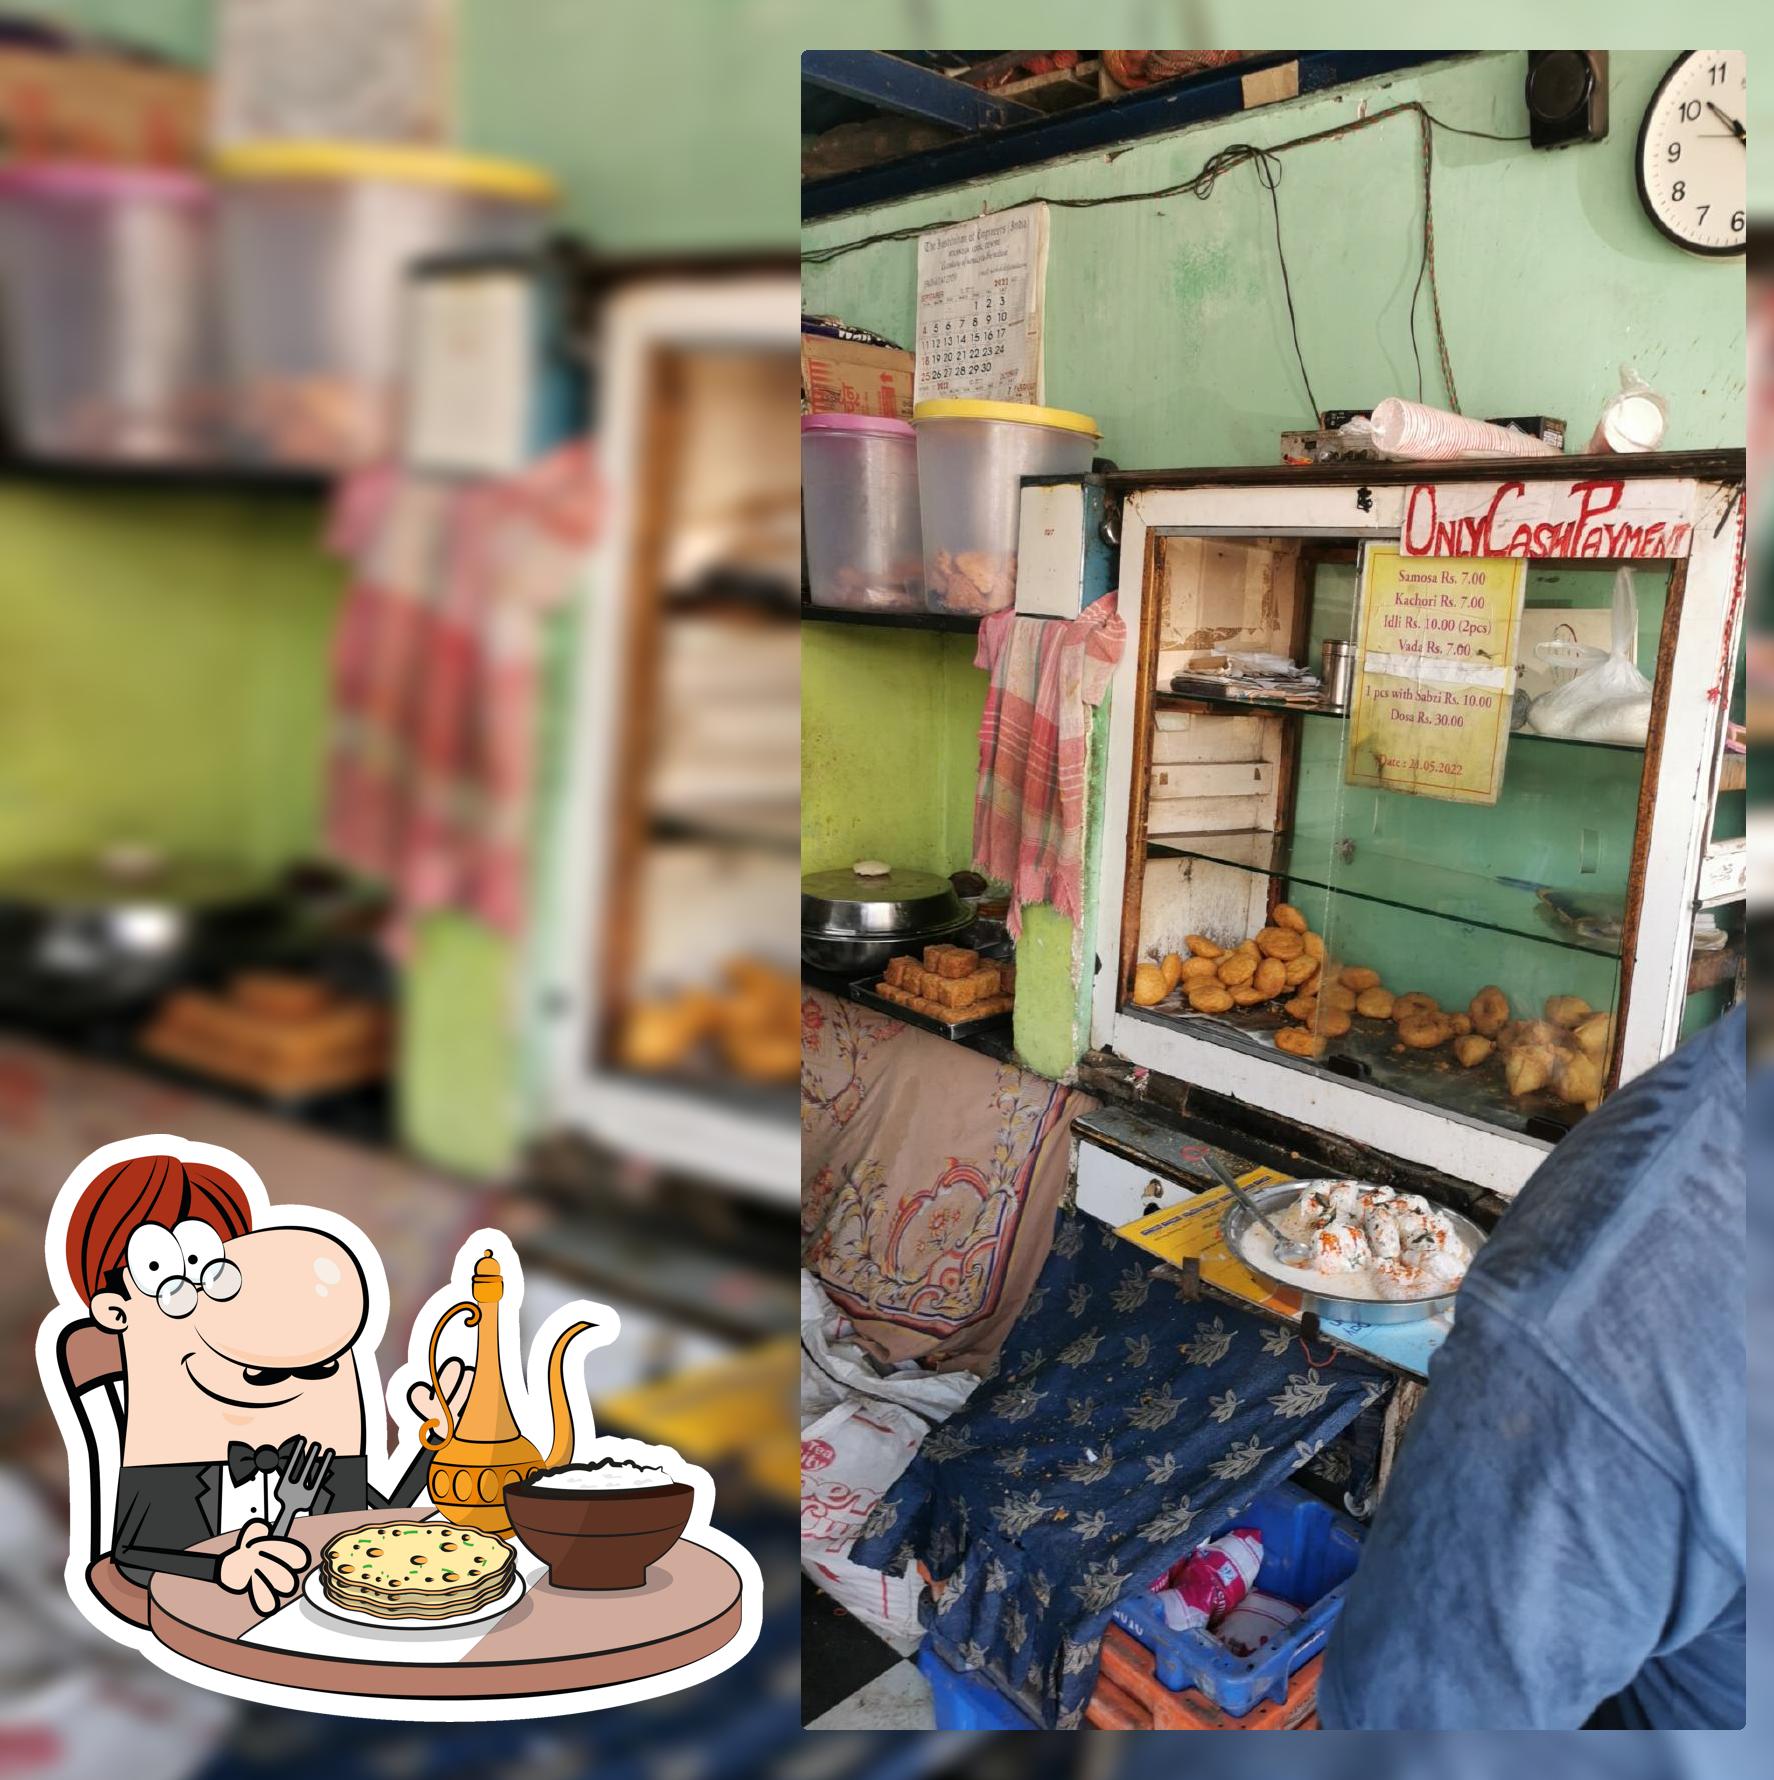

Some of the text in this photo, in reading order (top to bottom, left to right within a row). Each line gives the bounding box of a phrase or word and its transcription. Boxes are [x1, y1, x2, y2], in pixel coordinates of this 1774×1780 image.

[1708, 61, 1727, 86] 11
[1678, 100, 1702, 123] 10
[1667, 142, 1681, 163] 9
[1671, 180, 1686, 202] 8
[1696, 205, 1711, 226] 7
[1730, 211, 1745, 232] 6
[986, 299, 992, 308] 2
[1000, 296, 1005, 306] 3
[933, 323, 939, 333] 5
[945, 321, 951, 330] 6
[960, 320, 965, 328] 7
[972, 317, 978, 327] 8
[986, 315, 991, 324] 9
[997, 312, 1007, 322] 10
[922, 328, 1006, 350] 11 12 13 14 15 16 17
[922, 345, 1005, 366] 18 19 20 21 22 23 24
[921, 362, 992, 382] 25 26 27 28 29 30
[1398, 569, 1486, 586] Samosa Rs. 7.00
[1395, 592, 1485, 609] Kachori Rs. 7.00
[1383, 614, 1492, 637] Idli Rs. 10.00 (2pcs)
[1399, 639, 1471, 657] Vada Rs. 7.00
[1366, 684, 1492, 709] 1 pcs with Sabzi Rs. 10.00
[1390, 708, 1464, 728] Dosa Rs. 30.00
[1376, 754, 1400, 768] Date
